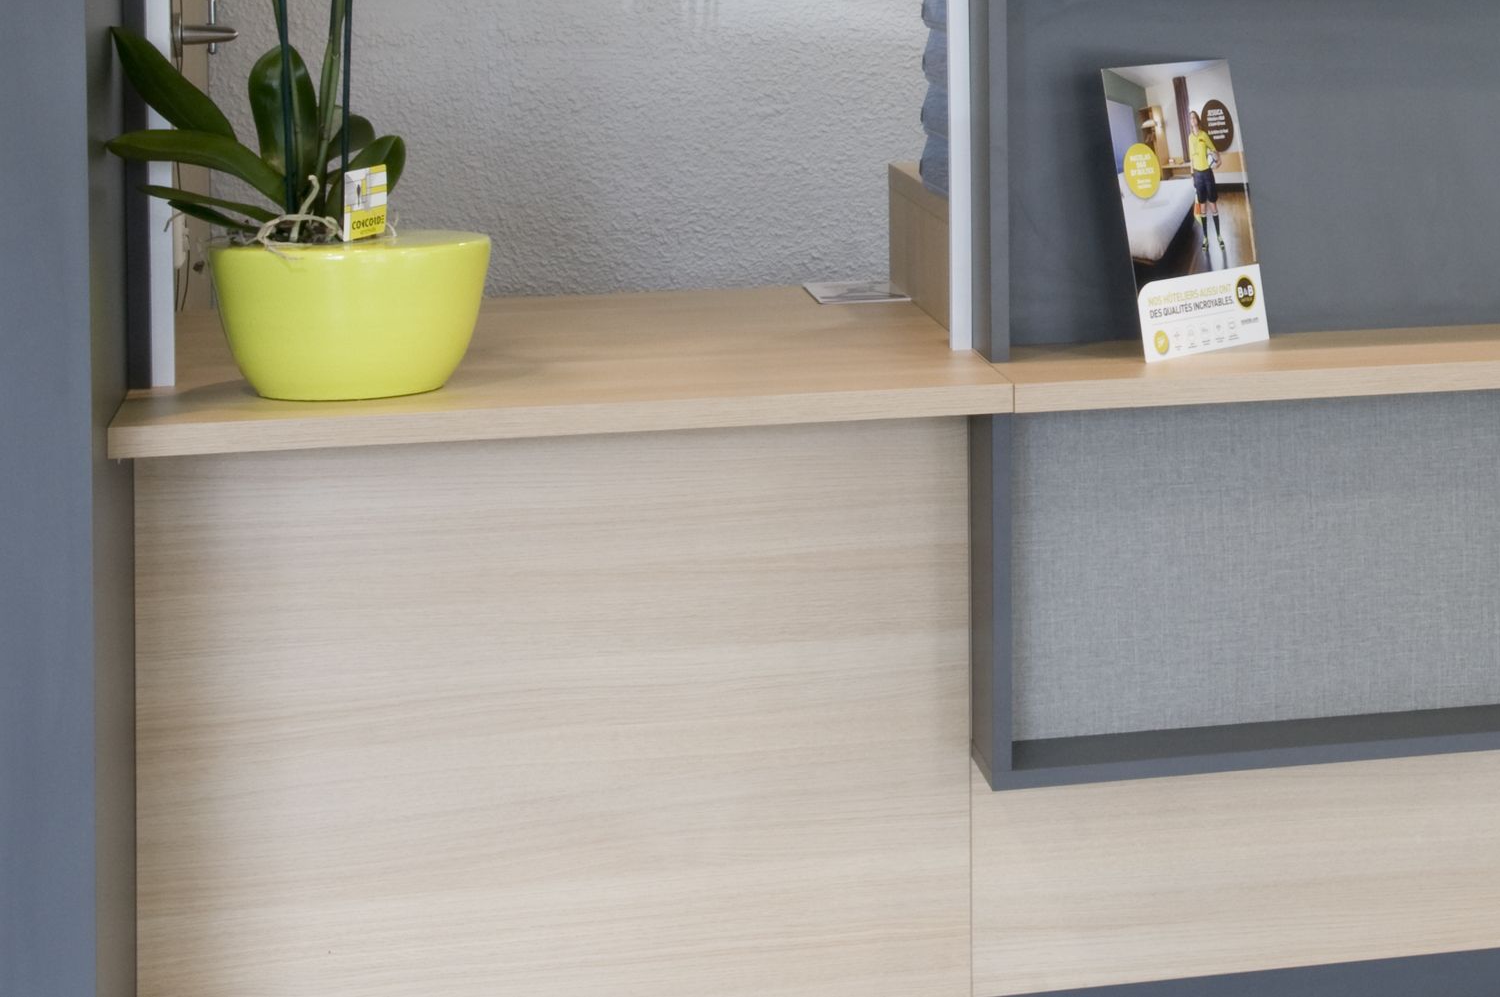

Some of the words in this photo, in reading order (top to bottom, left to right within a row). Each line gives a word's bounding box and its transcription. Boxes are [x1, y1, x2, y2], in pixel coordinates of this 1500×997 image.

[1237, 285, 1254, 299] B&B
[1149, 308, 1163, 320] DES
[1164, 300, 1193, 316] QUALITÉS
